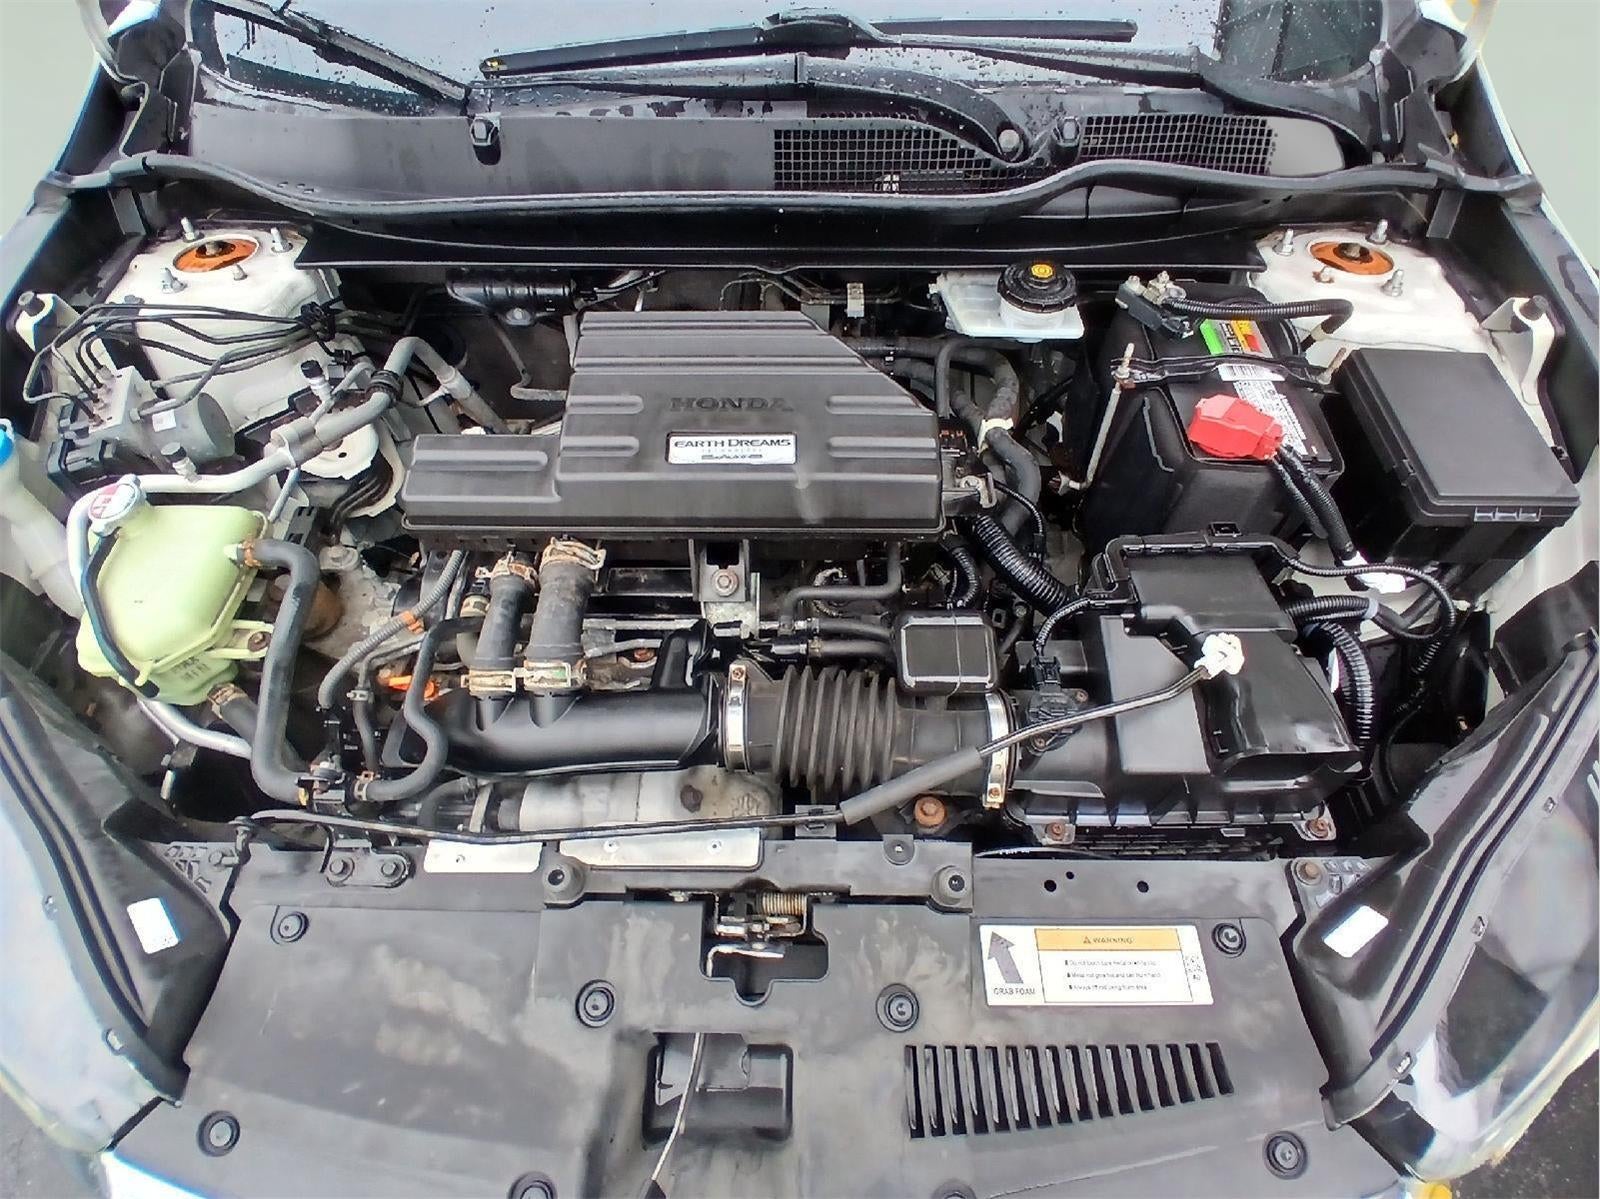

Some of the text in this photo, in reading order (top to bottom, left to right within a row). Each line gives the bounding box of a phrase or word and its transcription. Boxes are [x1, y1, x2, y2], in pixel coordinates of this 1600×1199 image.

[669, 396, 794, 412] HONDA
[674, 438, 791, 448] EARTH DREAMS
[993, 987, 1035, 996] GRAB FOAM
